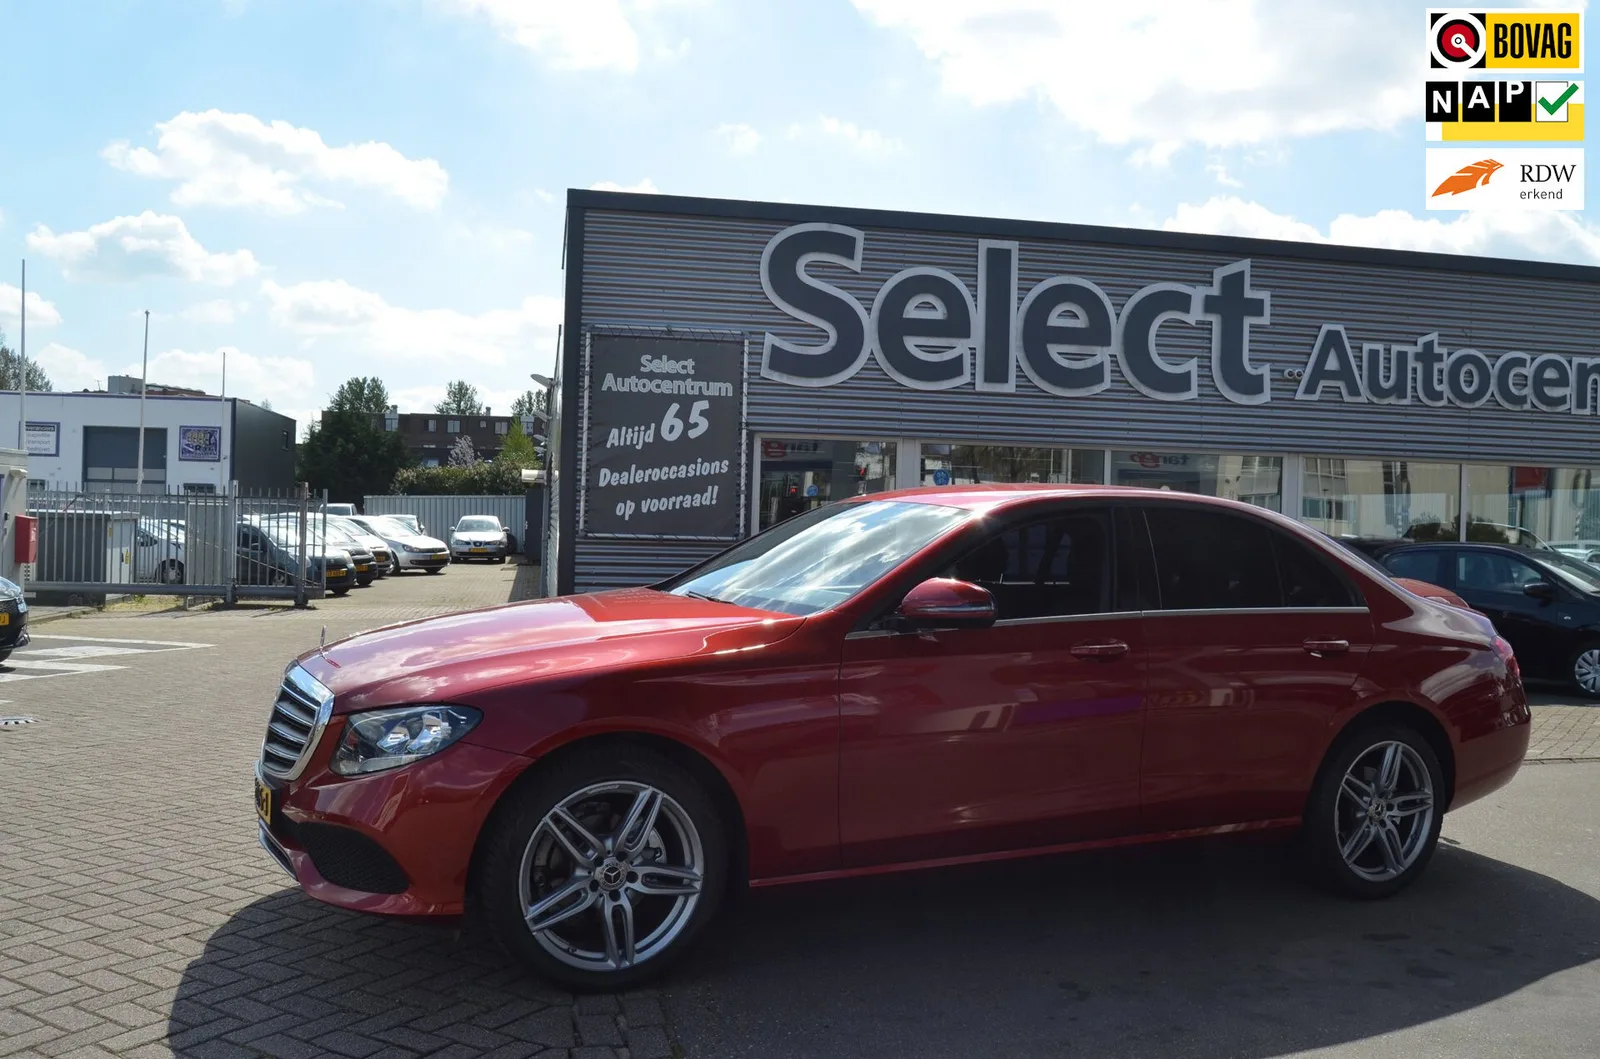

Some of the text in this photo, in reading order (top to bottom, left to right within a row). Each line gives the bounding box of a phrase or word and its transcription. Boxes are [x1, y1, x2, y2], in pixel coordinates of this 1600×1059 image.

[760, 222, 1272, 405] Select
[640, 355, 695, 375] Select
[601, 373, 733, 396] Autocentrum
[606, 400, 710, 450] Altijd 65
[599, 458, 729, 487] Dealeroccasions
[616, 485, 719, 521] op voorraad!
